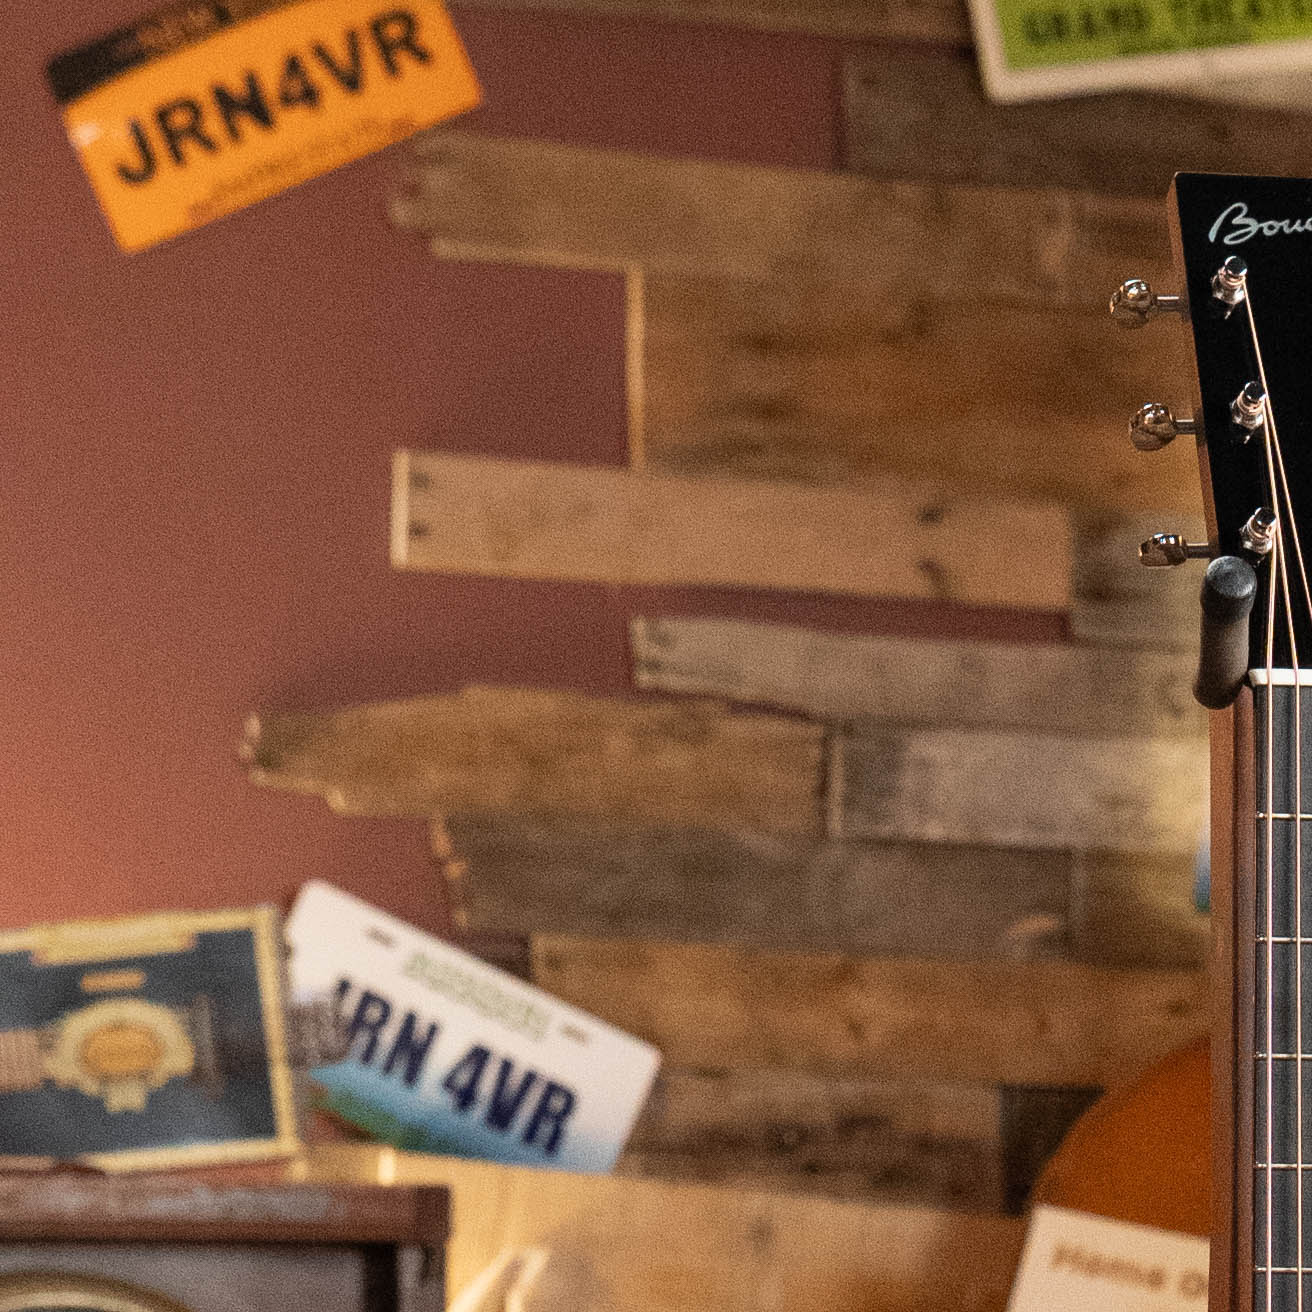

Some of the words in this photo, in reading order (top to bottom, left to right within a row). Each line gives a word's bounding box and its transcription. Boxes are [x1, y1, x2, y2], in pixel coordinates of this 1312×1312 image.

[116, 8, 434, 187] JRN4VR
[335, 976, 438, 1087] RN
[443, 1043, 577, 1158] 4VR
